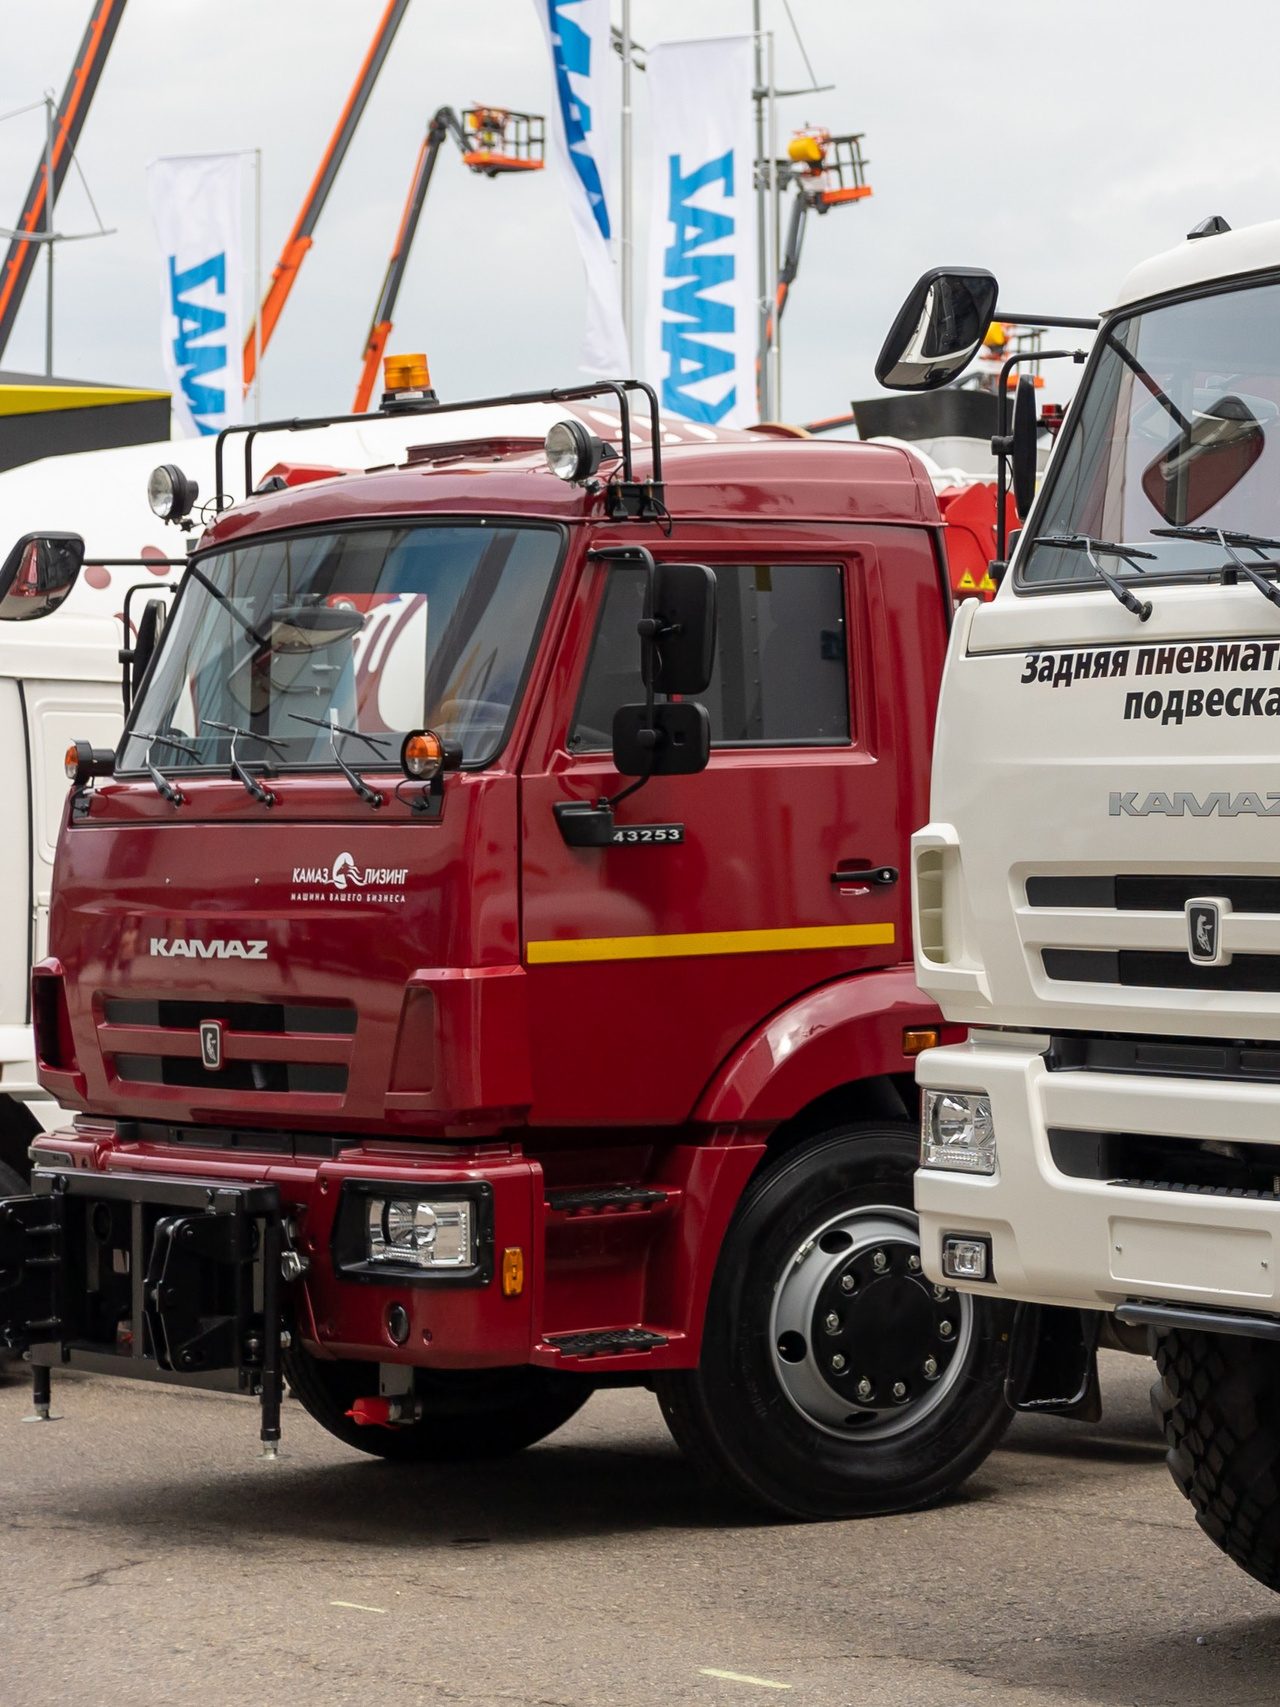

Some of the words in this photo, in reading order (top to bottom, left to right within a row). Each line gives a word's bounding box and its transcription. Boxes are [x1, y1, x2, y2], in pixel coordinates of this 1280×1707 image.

[1020, 650, 1130, 688] Задняя
[613, 829, 680, 842] 43253
[292, 867, 329, 883] КАМАЗ
[363, 868, 409, 885] ЛИЗИНГ
[290, 892, 326, 901] МАШИНА
[329, 893, 363, 902] ВАШЕГО
[366, 894, 406, 903] БИЗНЕСА
[150, 937, 268, 960] KAMAZ
